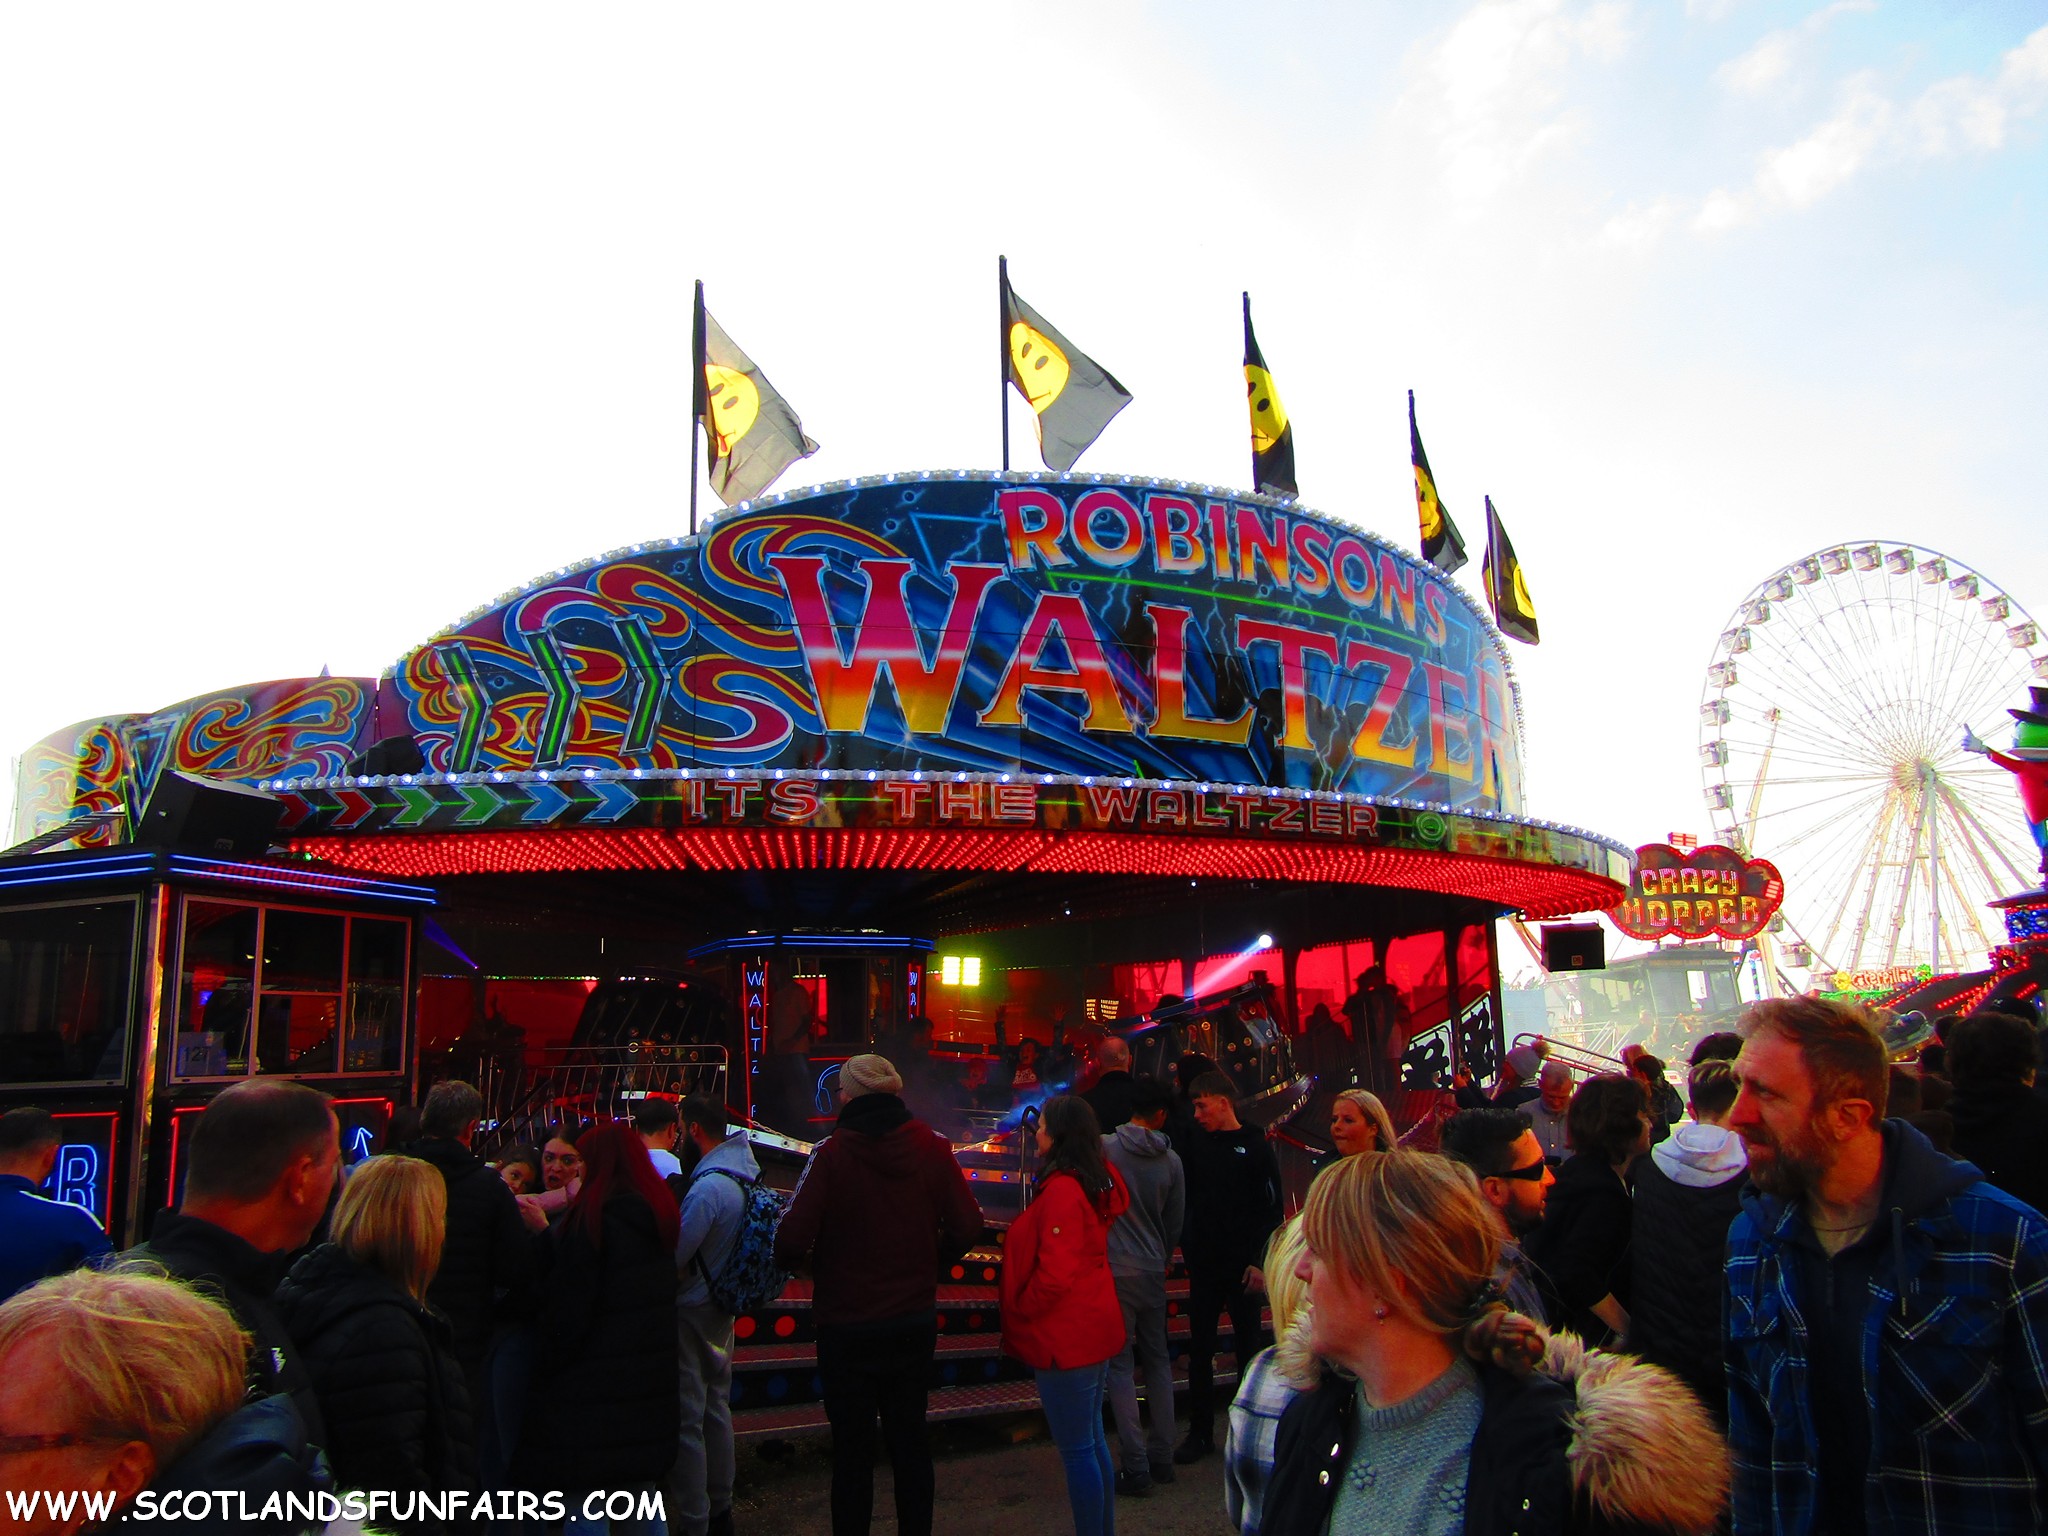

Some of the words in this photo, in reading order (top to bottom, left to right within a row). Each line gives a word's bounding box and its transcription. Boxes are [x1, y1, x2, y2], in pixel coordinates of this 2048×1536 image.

[994, 484, 1450, 647] ROBINSON'S
[766, 552, 1517, 806] WALTZER
[690, 778, 820, 821] ITS
[884, 781, 1037, 821] THE
[1088, 787, 1379, 838] WALTZER
[1622, 896, 1760, 927] HOPPER
[1640, 867, 1738, 896] CRAZY
